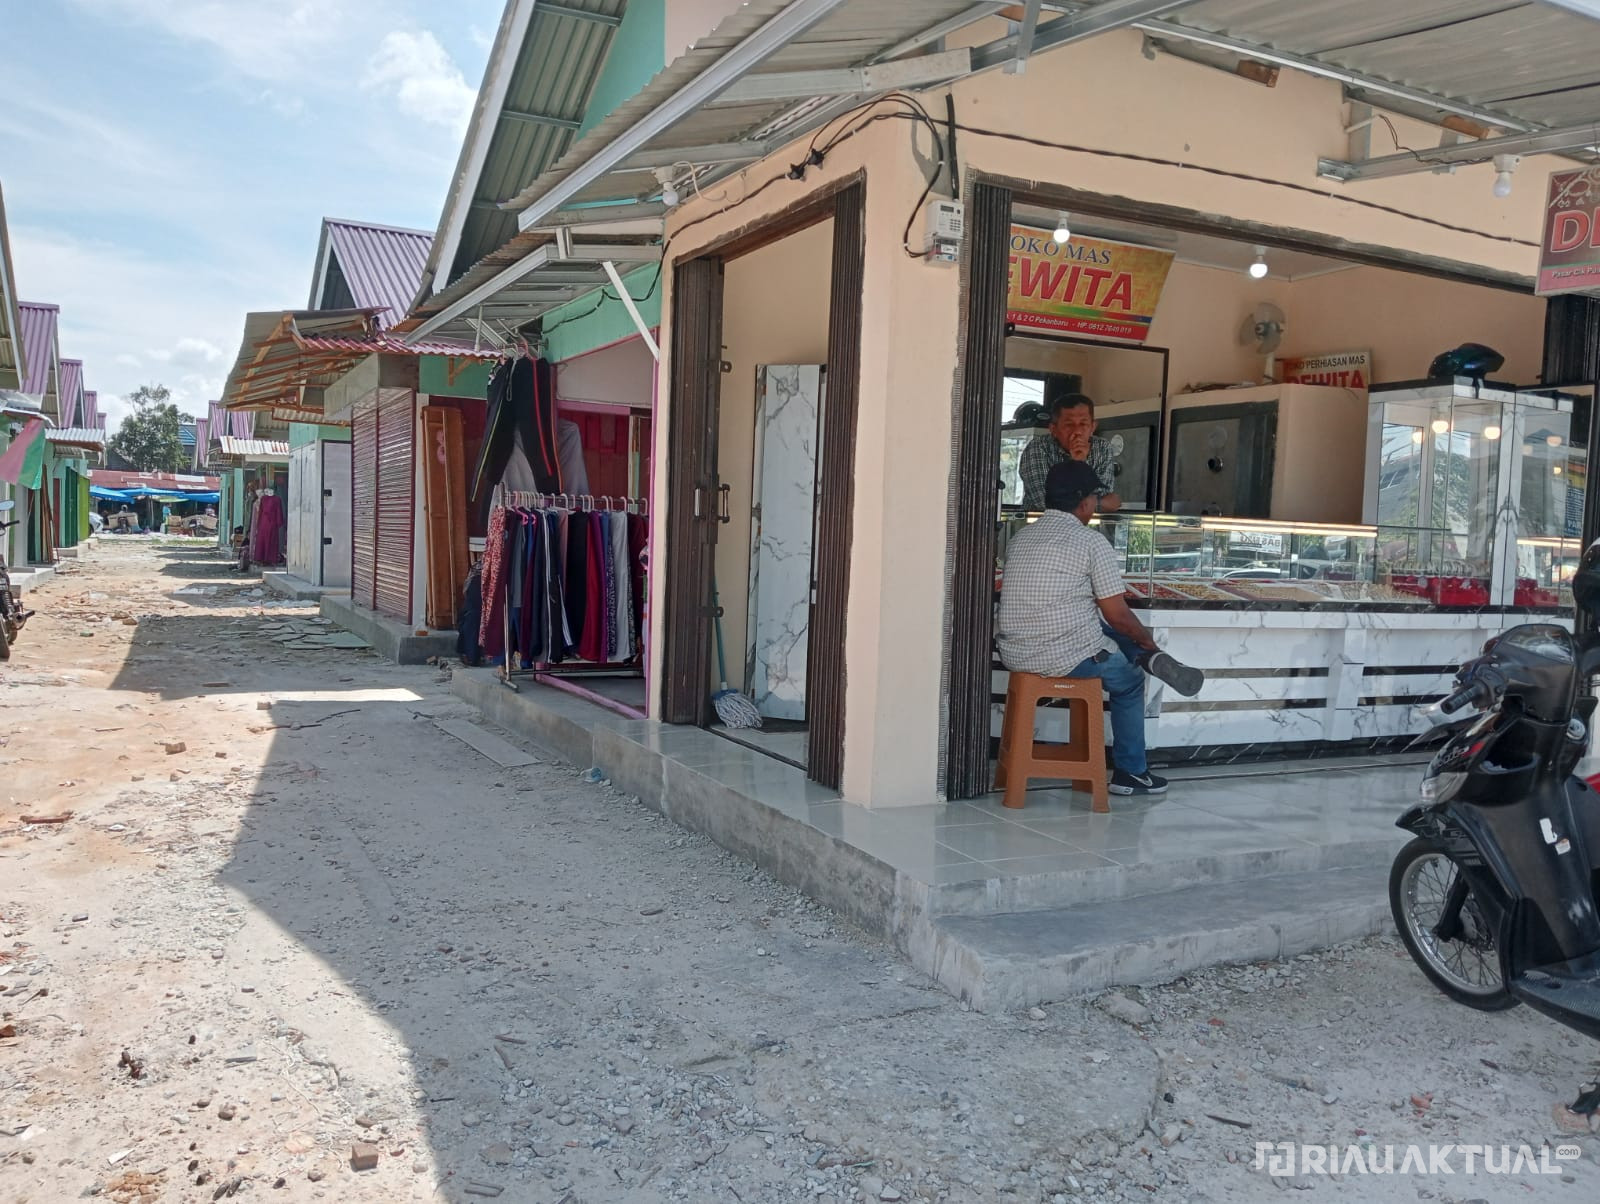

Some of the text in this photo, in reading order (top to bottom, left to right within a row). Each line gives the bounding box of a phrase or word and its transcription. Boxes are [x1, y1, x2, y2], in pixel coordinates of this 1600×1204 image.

[1011, 235, 1112, 265] OKO MAS
[1035, 316, 1068, 327] Pekanbaru
[1306, 357, 1347, 369] PERHIASAN
[1348, 355, 1365, 365] MAS
